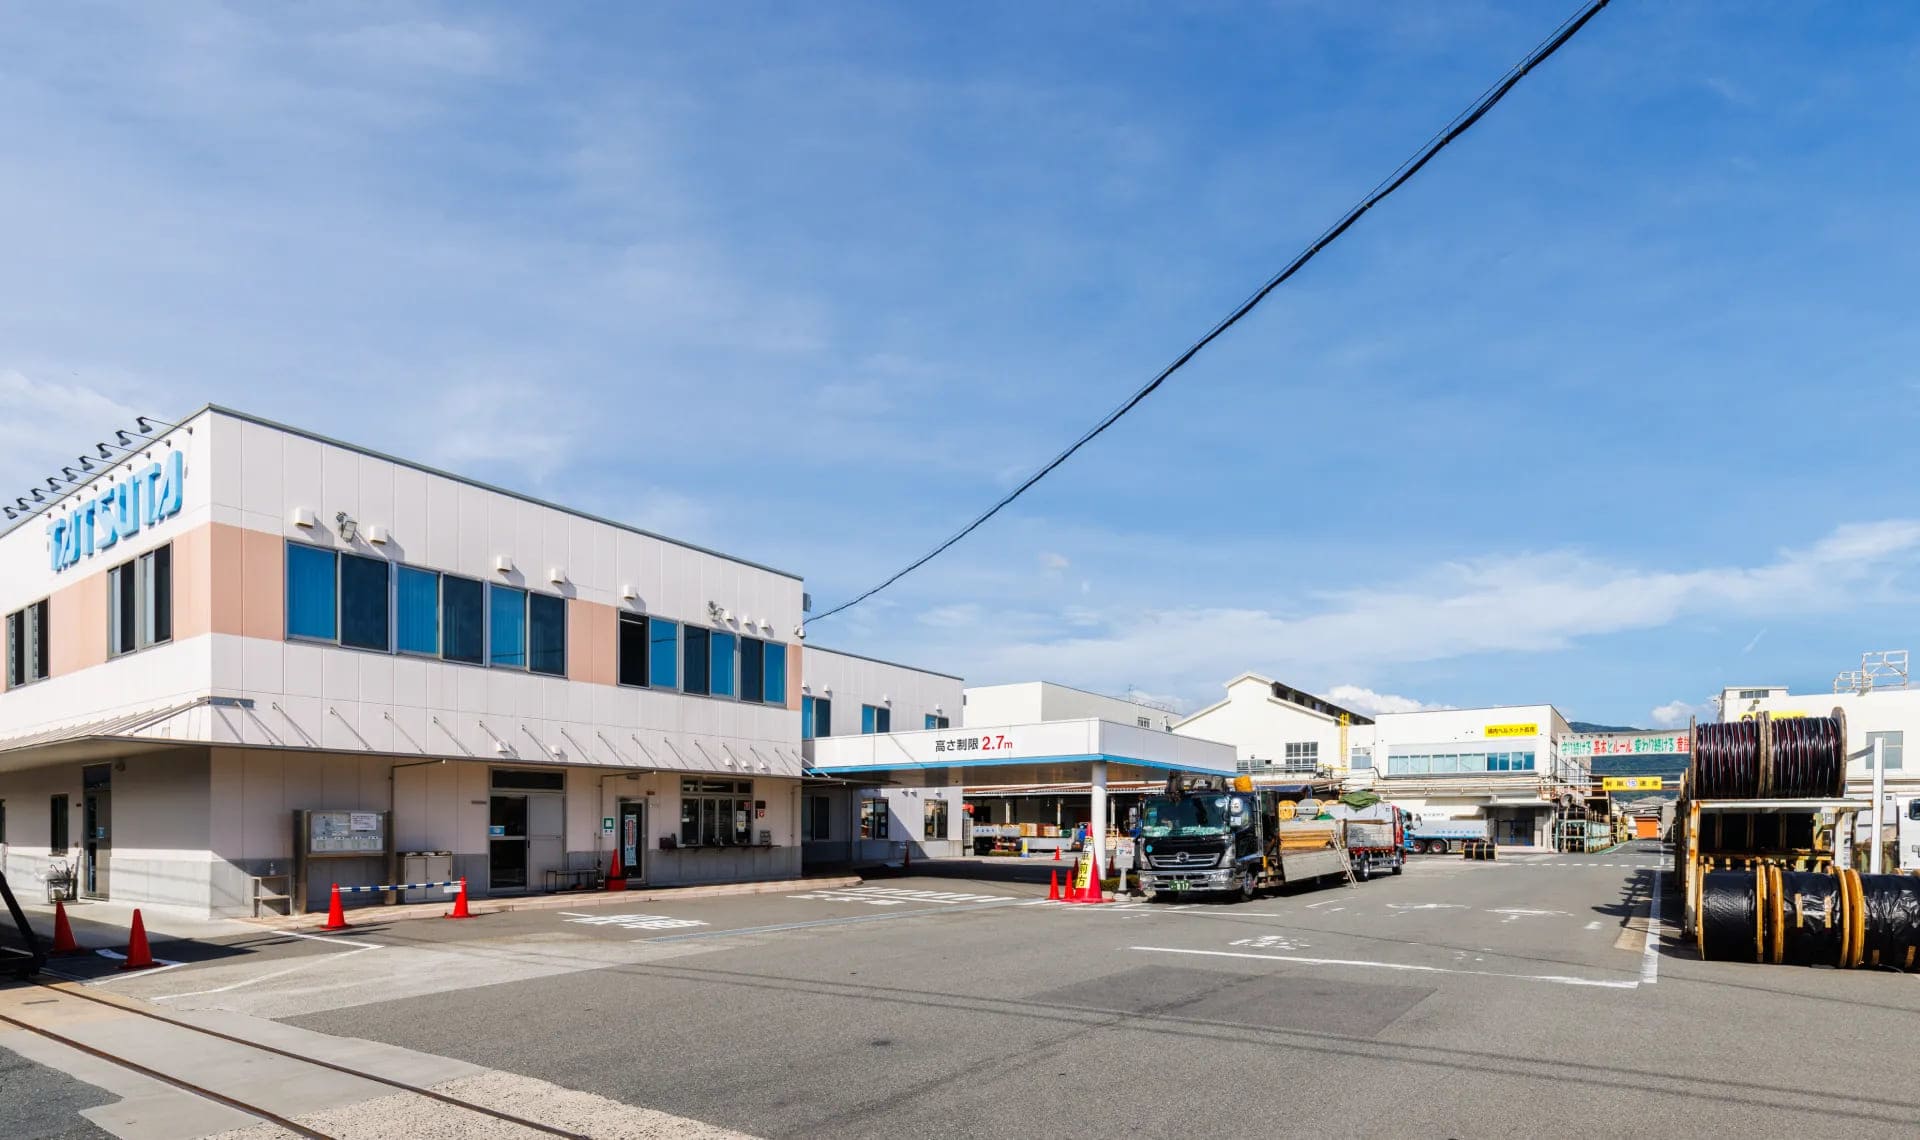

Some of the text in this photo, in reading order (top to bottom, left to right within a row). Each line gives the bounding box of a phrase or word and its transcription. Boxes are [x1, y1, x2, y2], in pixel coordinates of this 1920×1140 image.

[47, 450, 183, 572] TATSUTA
[935, 735, 1013, 752] 高さ制限 2.7m
